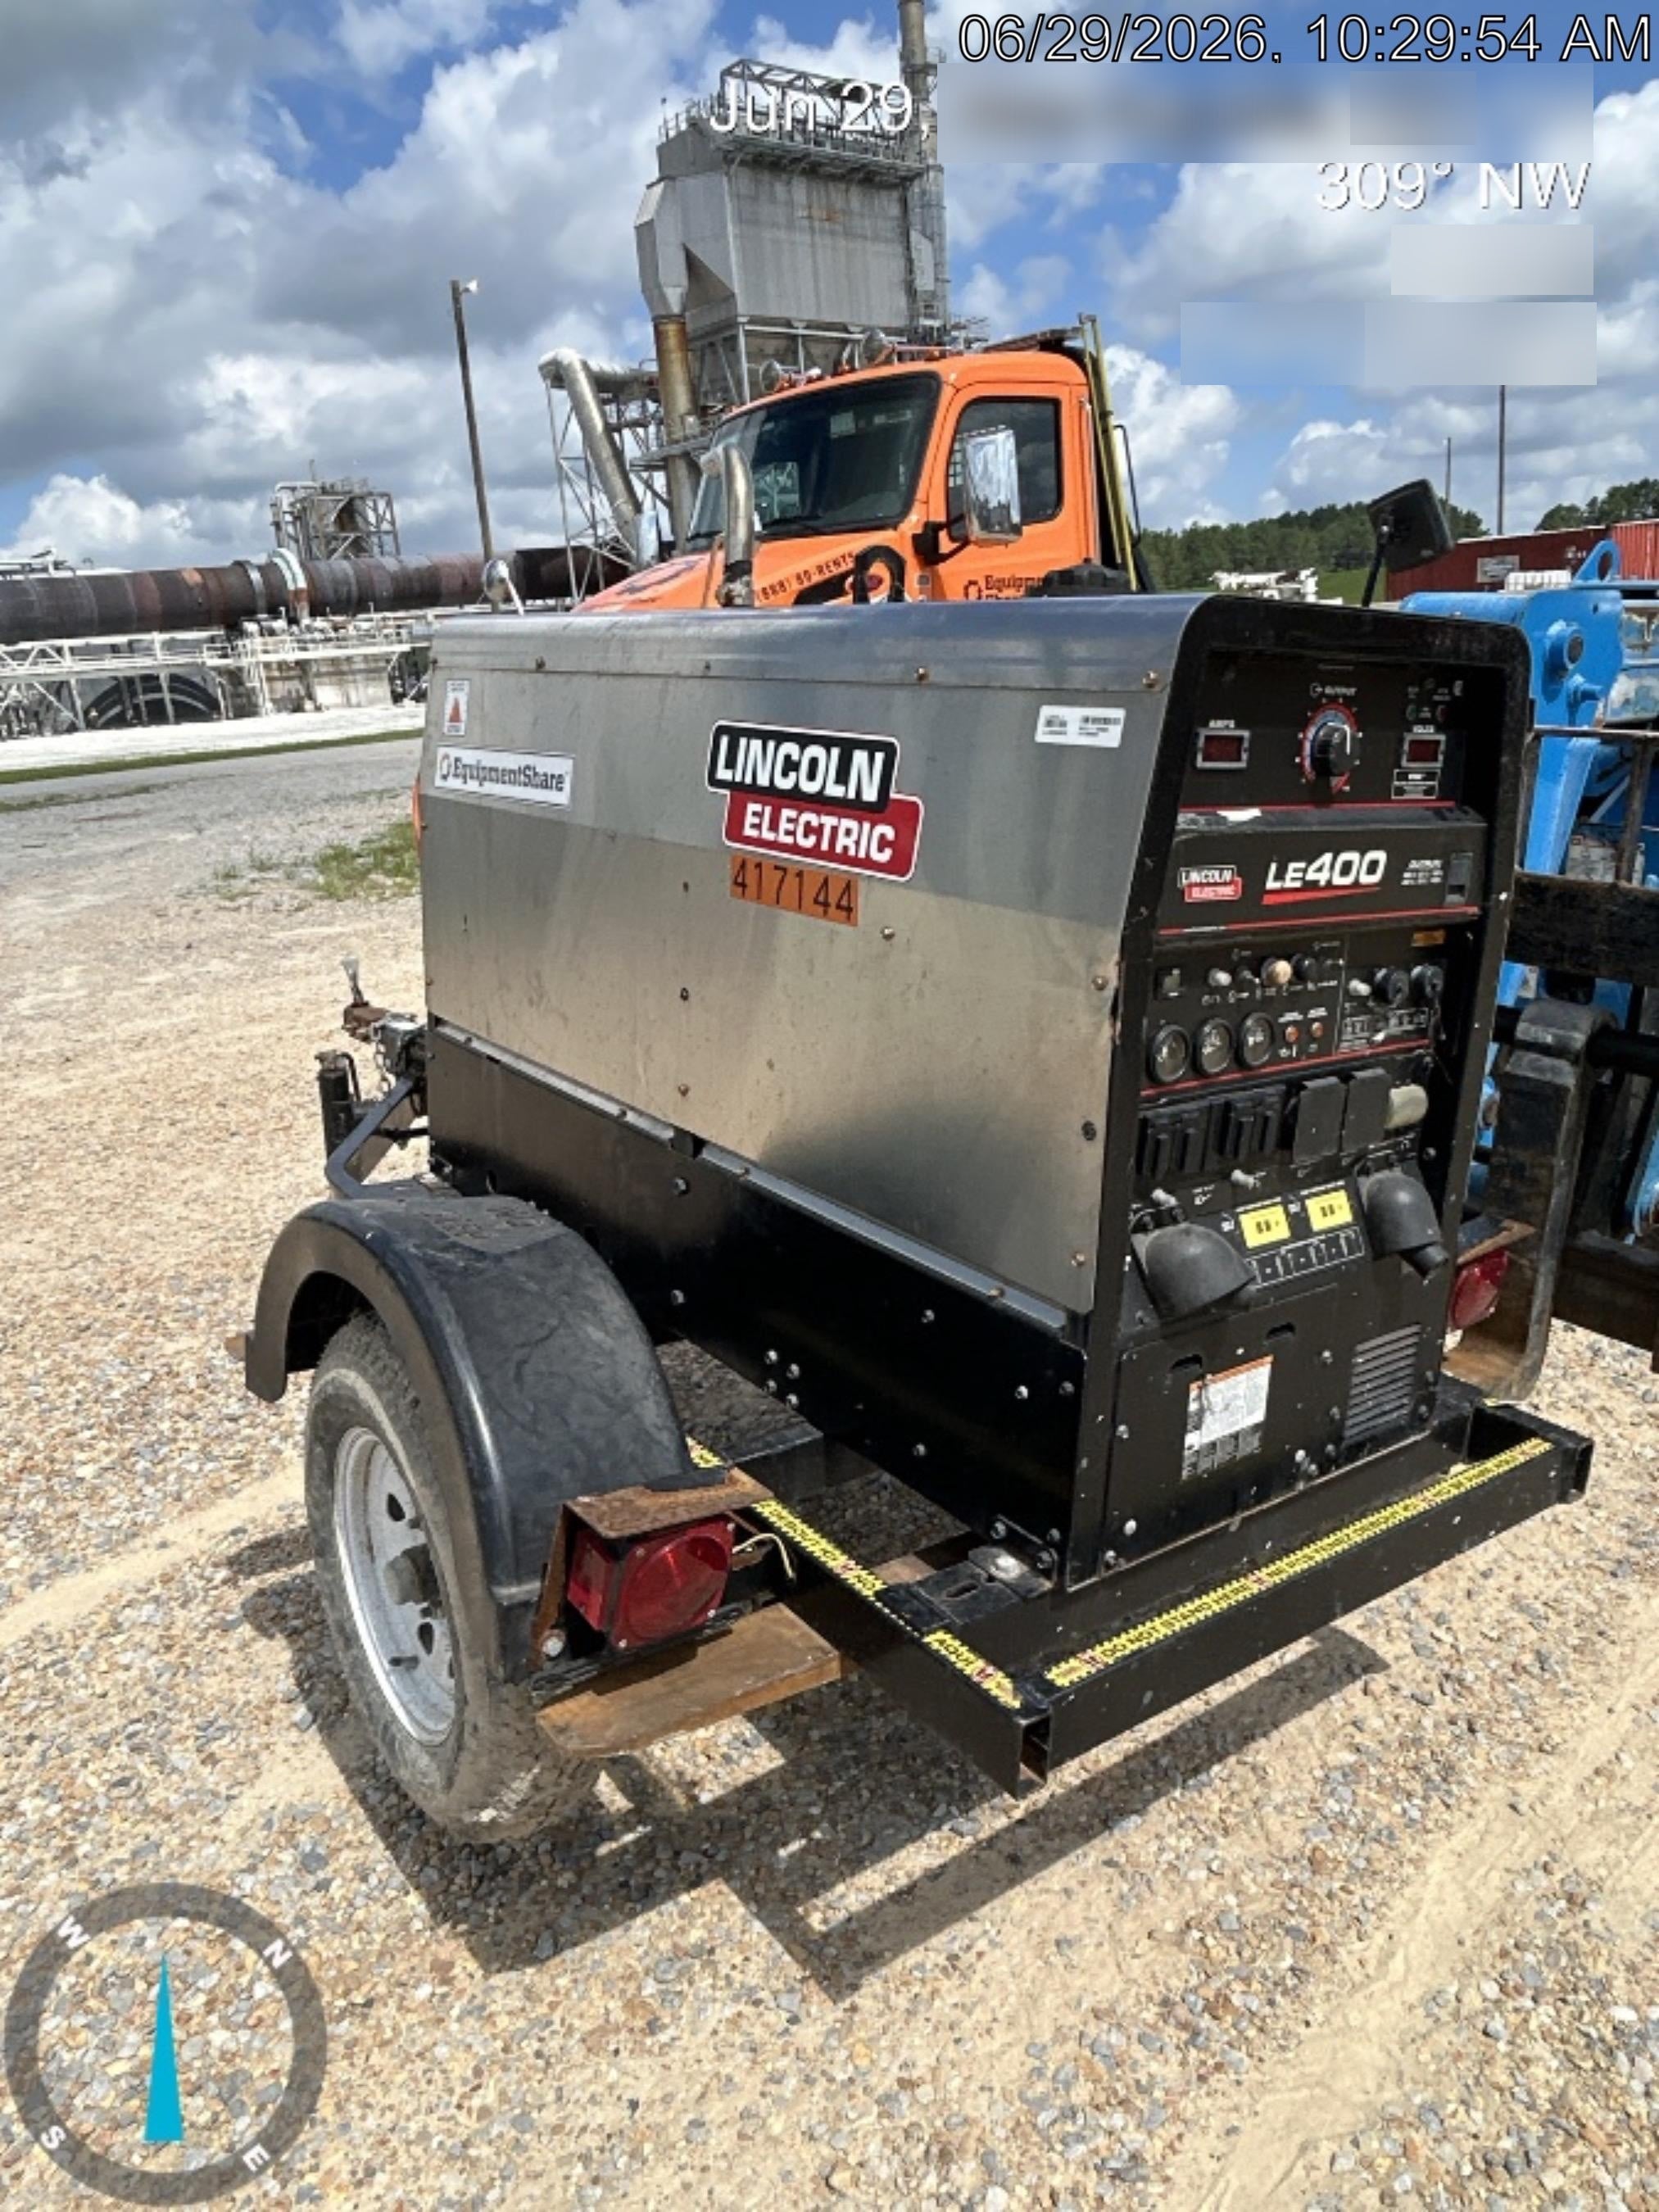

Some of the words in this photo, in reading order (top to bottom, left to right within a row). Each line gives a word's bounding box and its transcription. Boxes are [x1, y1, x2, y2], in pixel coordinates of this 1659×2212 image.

[451, 755, 566, 792] EquipmentShare
[714, 734, 886, 803] LINCOLN
[742, 802, 896, 864] ELECTRIC
[732, 858, 854, 923] 417144
[1181, 869, 1233, 886] LINCOLN
[1264, 850, 1388, 891] LE400
